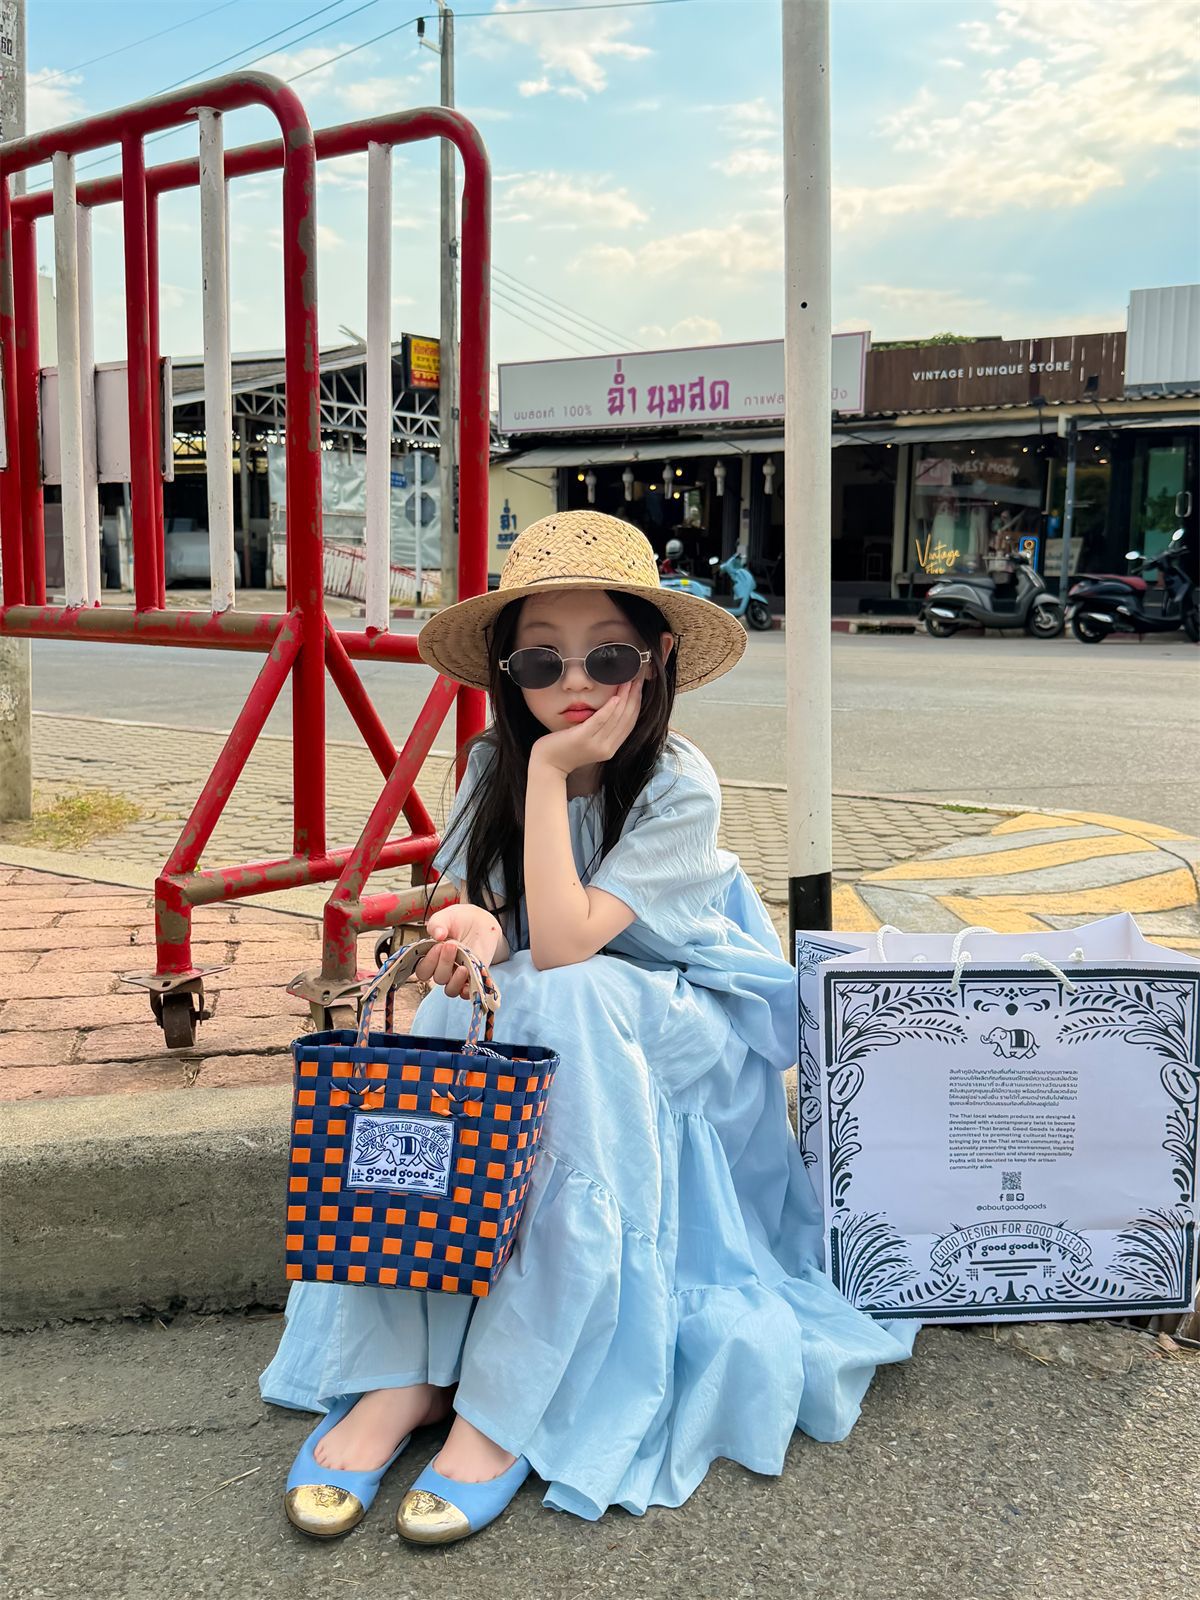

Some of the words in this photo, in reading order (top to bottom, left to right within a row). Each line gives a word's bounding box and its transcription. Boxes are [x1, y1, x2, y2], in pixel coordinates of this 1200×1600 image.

[912, 368, 964, 381] VINTAGE
[976, 364, 1024, 377] UNIQUE
[1028, 361, 1072, 373] STORE
[646, 376, 730, 419] นมสด
[563, 404, 592, 417] 100%
[915, 533, 960, 567] Vintage
[360, 1129, 377, 1143] GOOD
[378, 1123, 400, 1133] DESIGN
[414, 1125, 430, 1136] GOOD
[430, 1133, 448, 1151] DEEDS
[365, 1167, 397, 1182] good
[398, 1168, 435, 1184] goods
[934, 1237, 960, 1261] GOOD
[960, 1224, 998, 1242] DESIGN
[1002, 1223, 1021, 1234] FOR
[1025, 1224, 1053, 1238] GOOD
[1055, 1231, 1088, 1257] DEEDS
[981, 1243, 1007, 1257] good
[1008, 1241, 1039, 1256] goods
